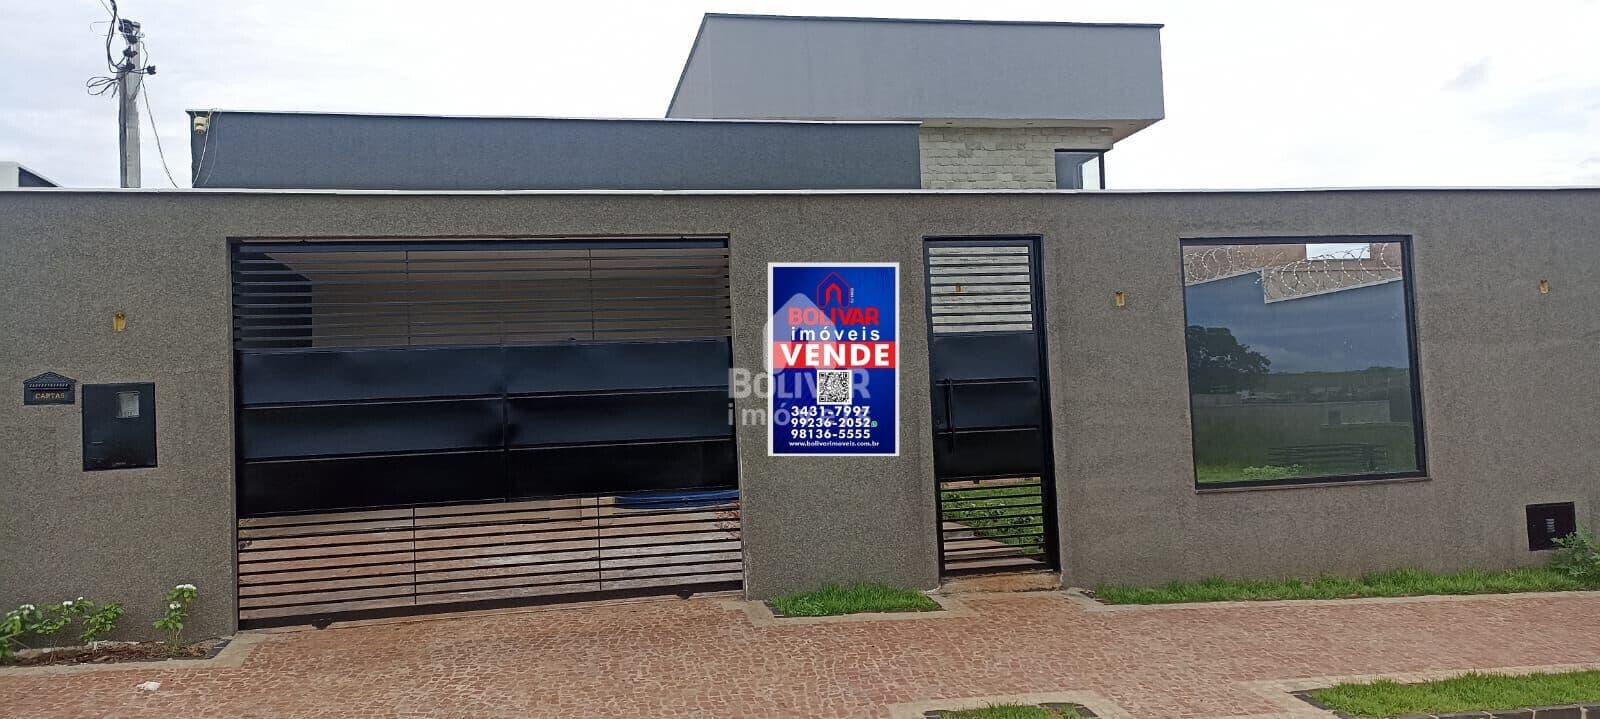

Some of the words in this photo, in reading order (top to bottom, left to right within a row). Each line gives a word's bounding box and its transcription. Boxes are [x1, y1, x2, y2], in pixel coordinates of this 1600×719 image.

[788, 307, 880, 326] BOLIVAR
[791, 326, 880, 341] imóveis
[781, 343, 890, 366] VENDE
[35, 392, 65, 400] CARTAS
[791, 405, 870, 417] 3431-7997
[791, 417, 871, 428] 99236-2052
[791, 429, 871, 439] 98136-5555
